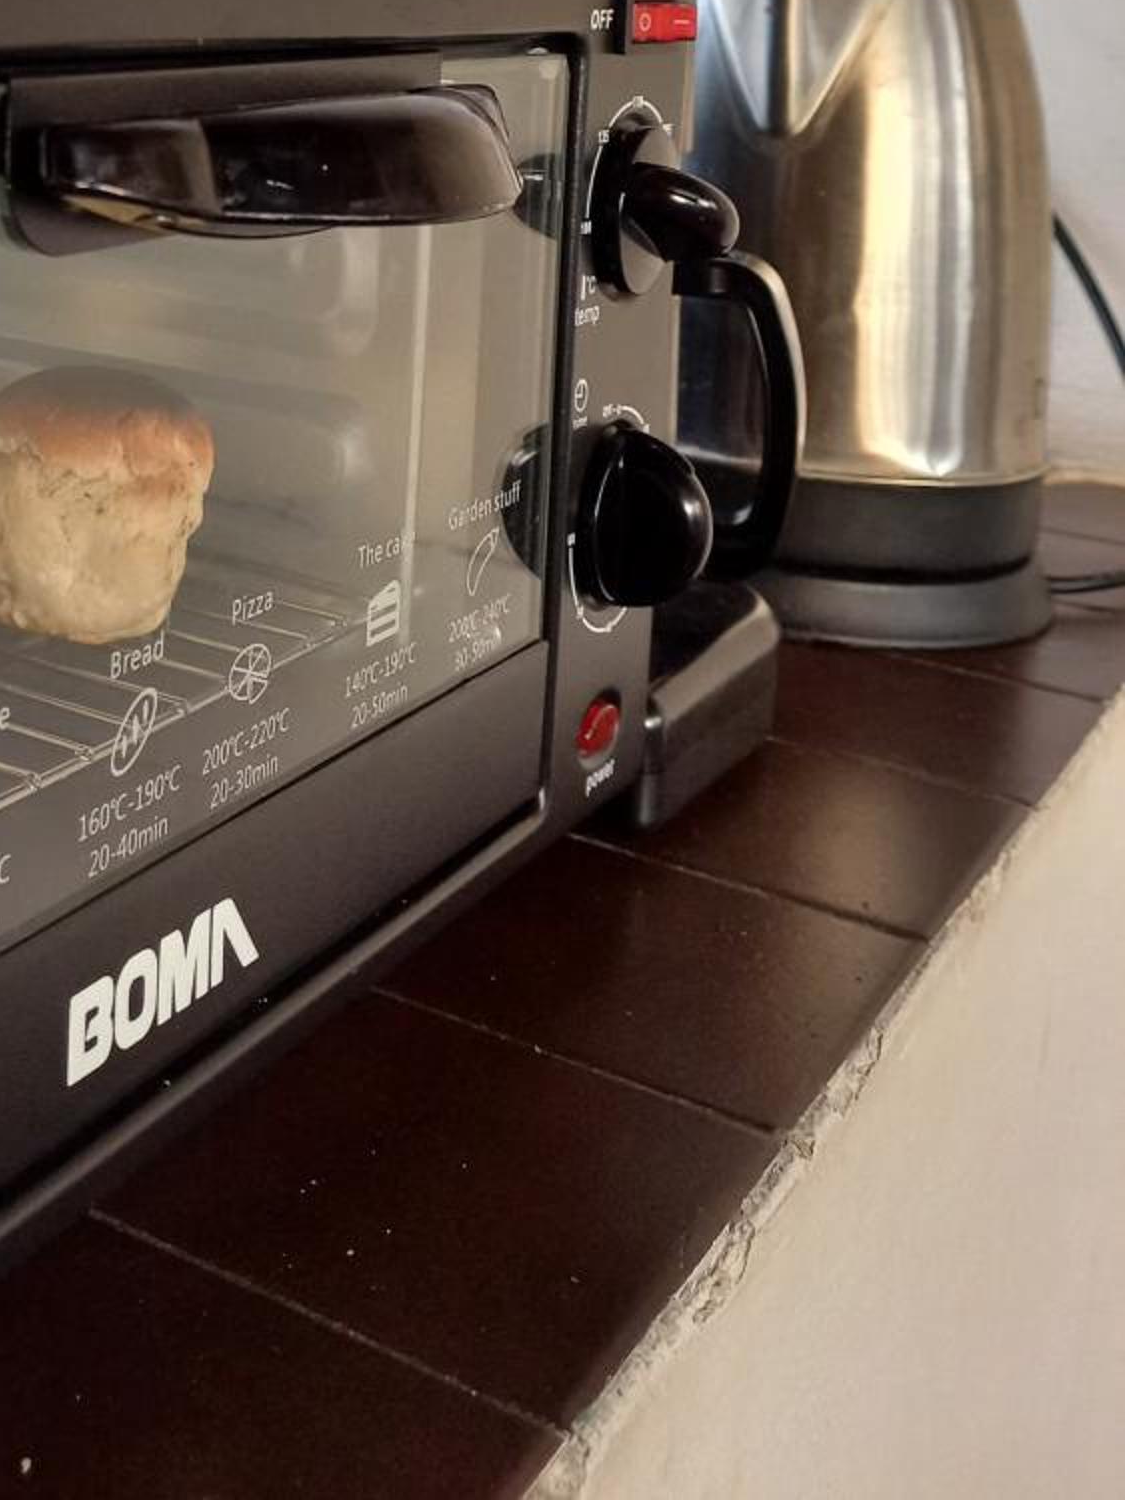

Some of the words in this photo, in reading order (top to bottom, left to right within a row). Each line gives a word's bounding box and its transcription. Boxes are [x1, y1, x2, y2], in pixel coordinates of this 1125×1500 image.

[590, 8, 614, 31] OFF
[574, 305, 600, 327] temp
[448, 496, 492, 530] Garden
[494, 479, 522, 511] stuff
[357, 543, 383, 570] The
[231, 589, 274, 626] Pizza
[109, 633, 165, 681] Bread
[209, 753, 280, 810] 20-30min
[88, 815, 169, 878] 20-40min
[66, 897, 261, 1087] BOMA
